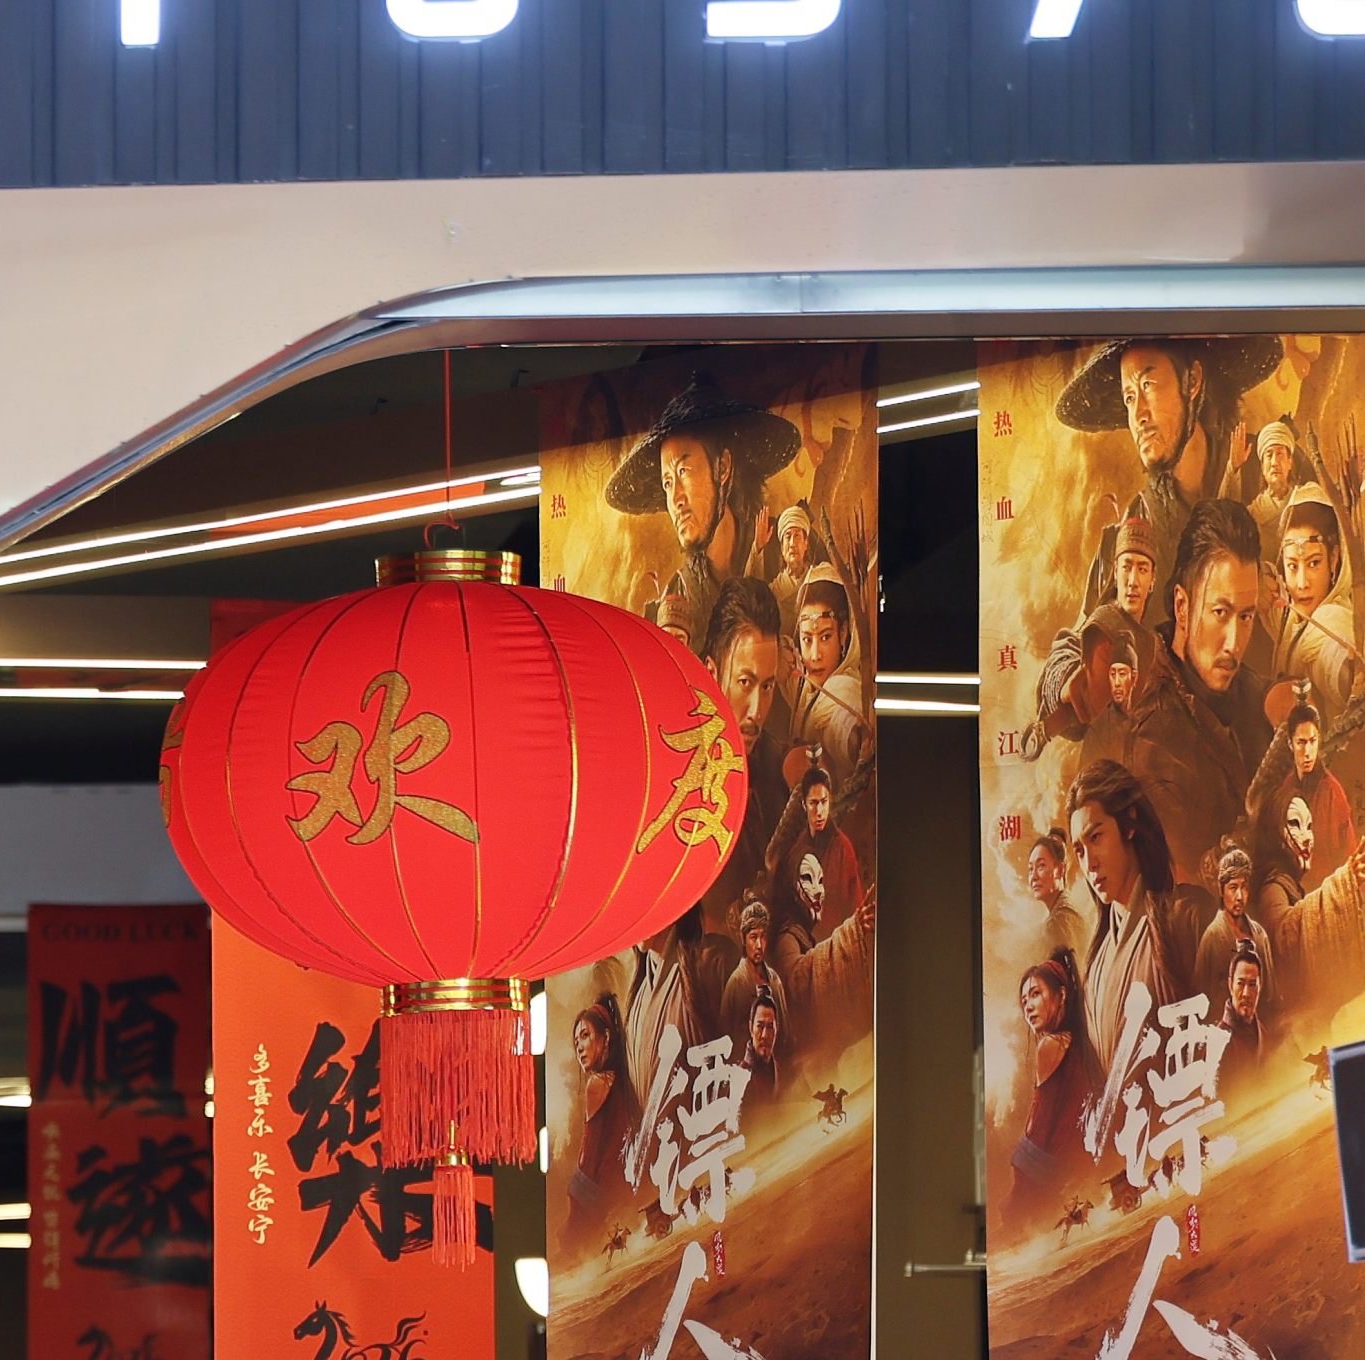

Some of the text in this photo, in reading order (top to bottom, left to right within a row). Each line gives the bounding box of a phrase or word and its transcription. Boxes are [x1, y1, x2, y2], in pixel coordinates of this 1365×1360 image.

[285, 670, 480, 845] 欢
[248, 1043, 274, 1244] 多喜乐 长安宁
